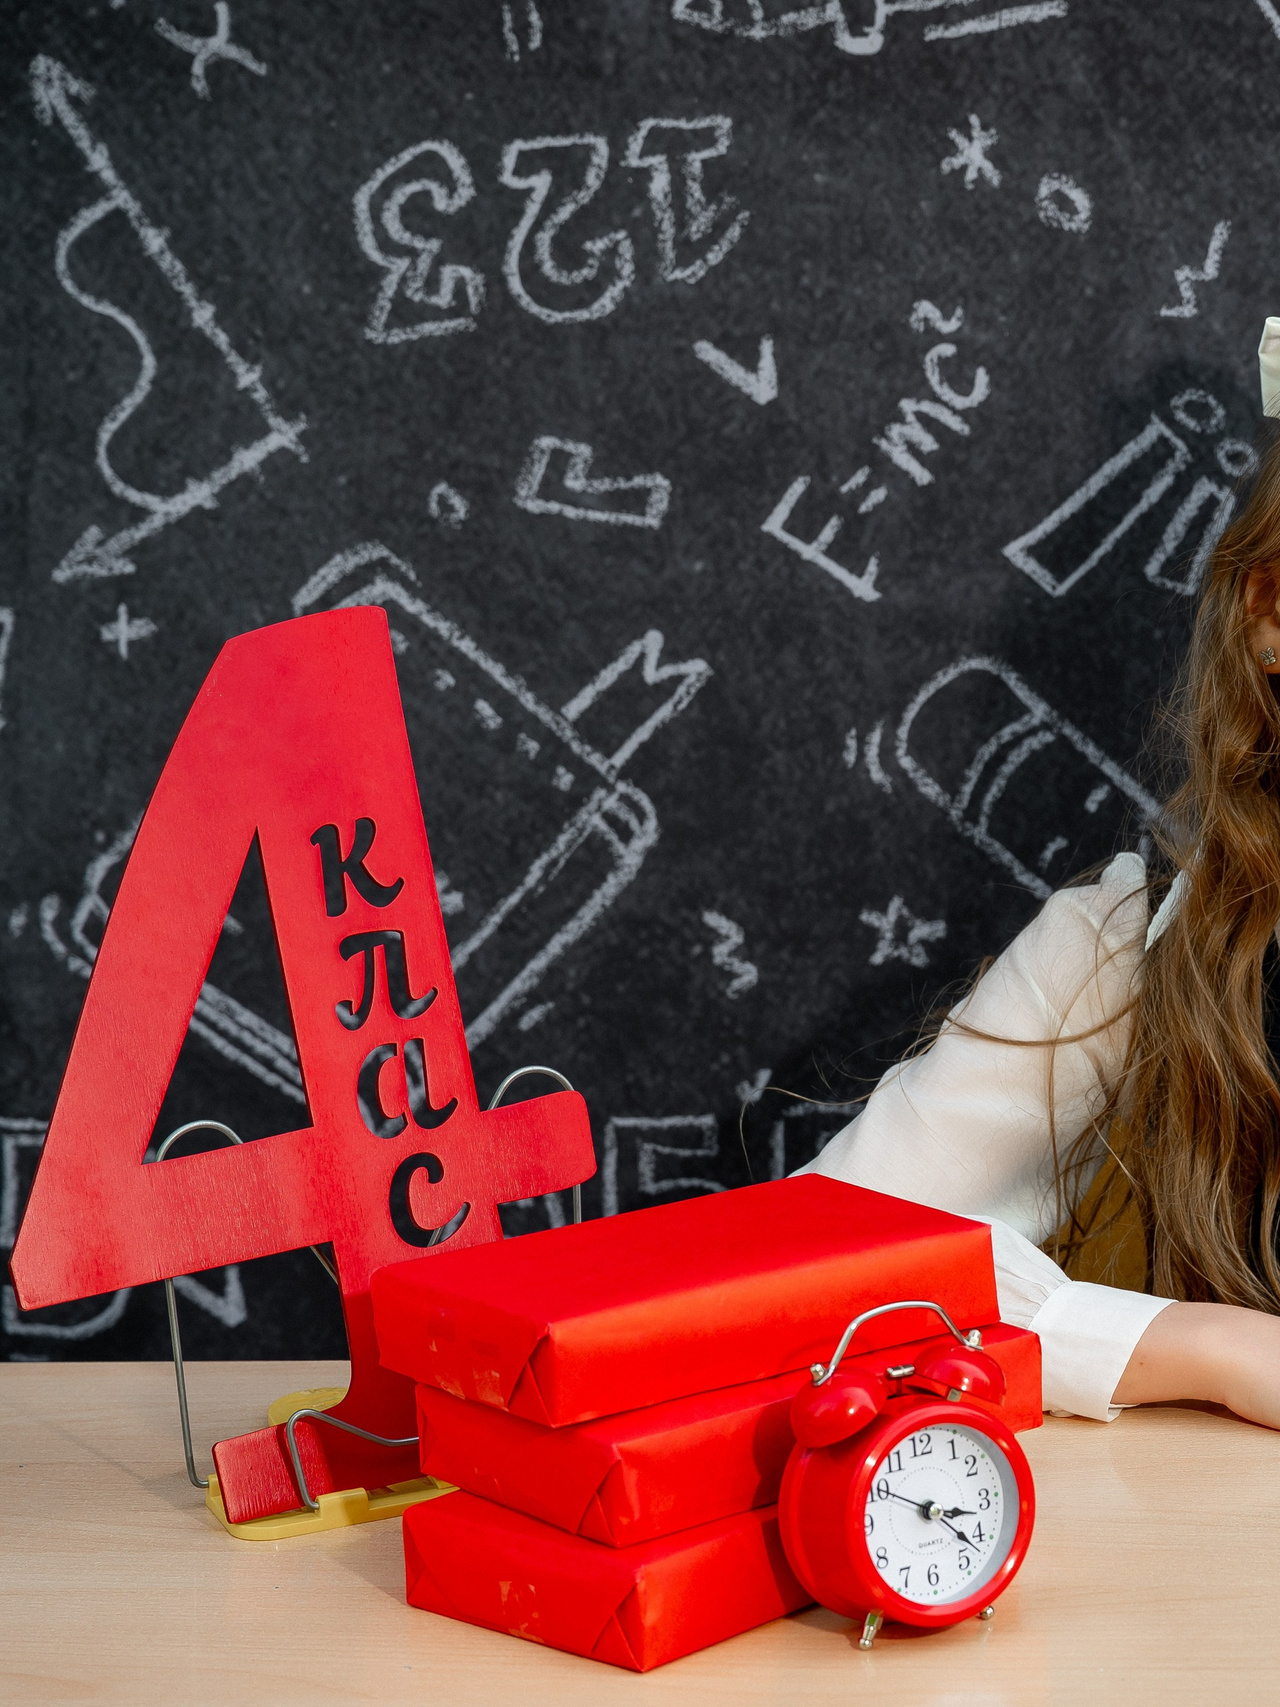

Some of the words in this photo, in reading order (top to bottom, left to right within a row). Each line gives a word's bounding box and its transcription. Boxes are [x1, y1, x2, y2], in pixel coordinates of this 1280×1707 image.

[7, 605, 597, 1526] 4
[908, 1433, 933, 1459] 12
[946, 1438, 960, 1461] 1
[884, 1449, 905, 1475] 11
[964, 1454, 979, 1477] 2
[978, 1488, 991, 1511] 3
[972, 1521, 986, 1543] 4
[876, 1546, 889, 1569] 8
[958, 1547, 971, 1571] 5
[899, 1565, 911, 1588] 7
[927, 1563, 940, 1586] 6
